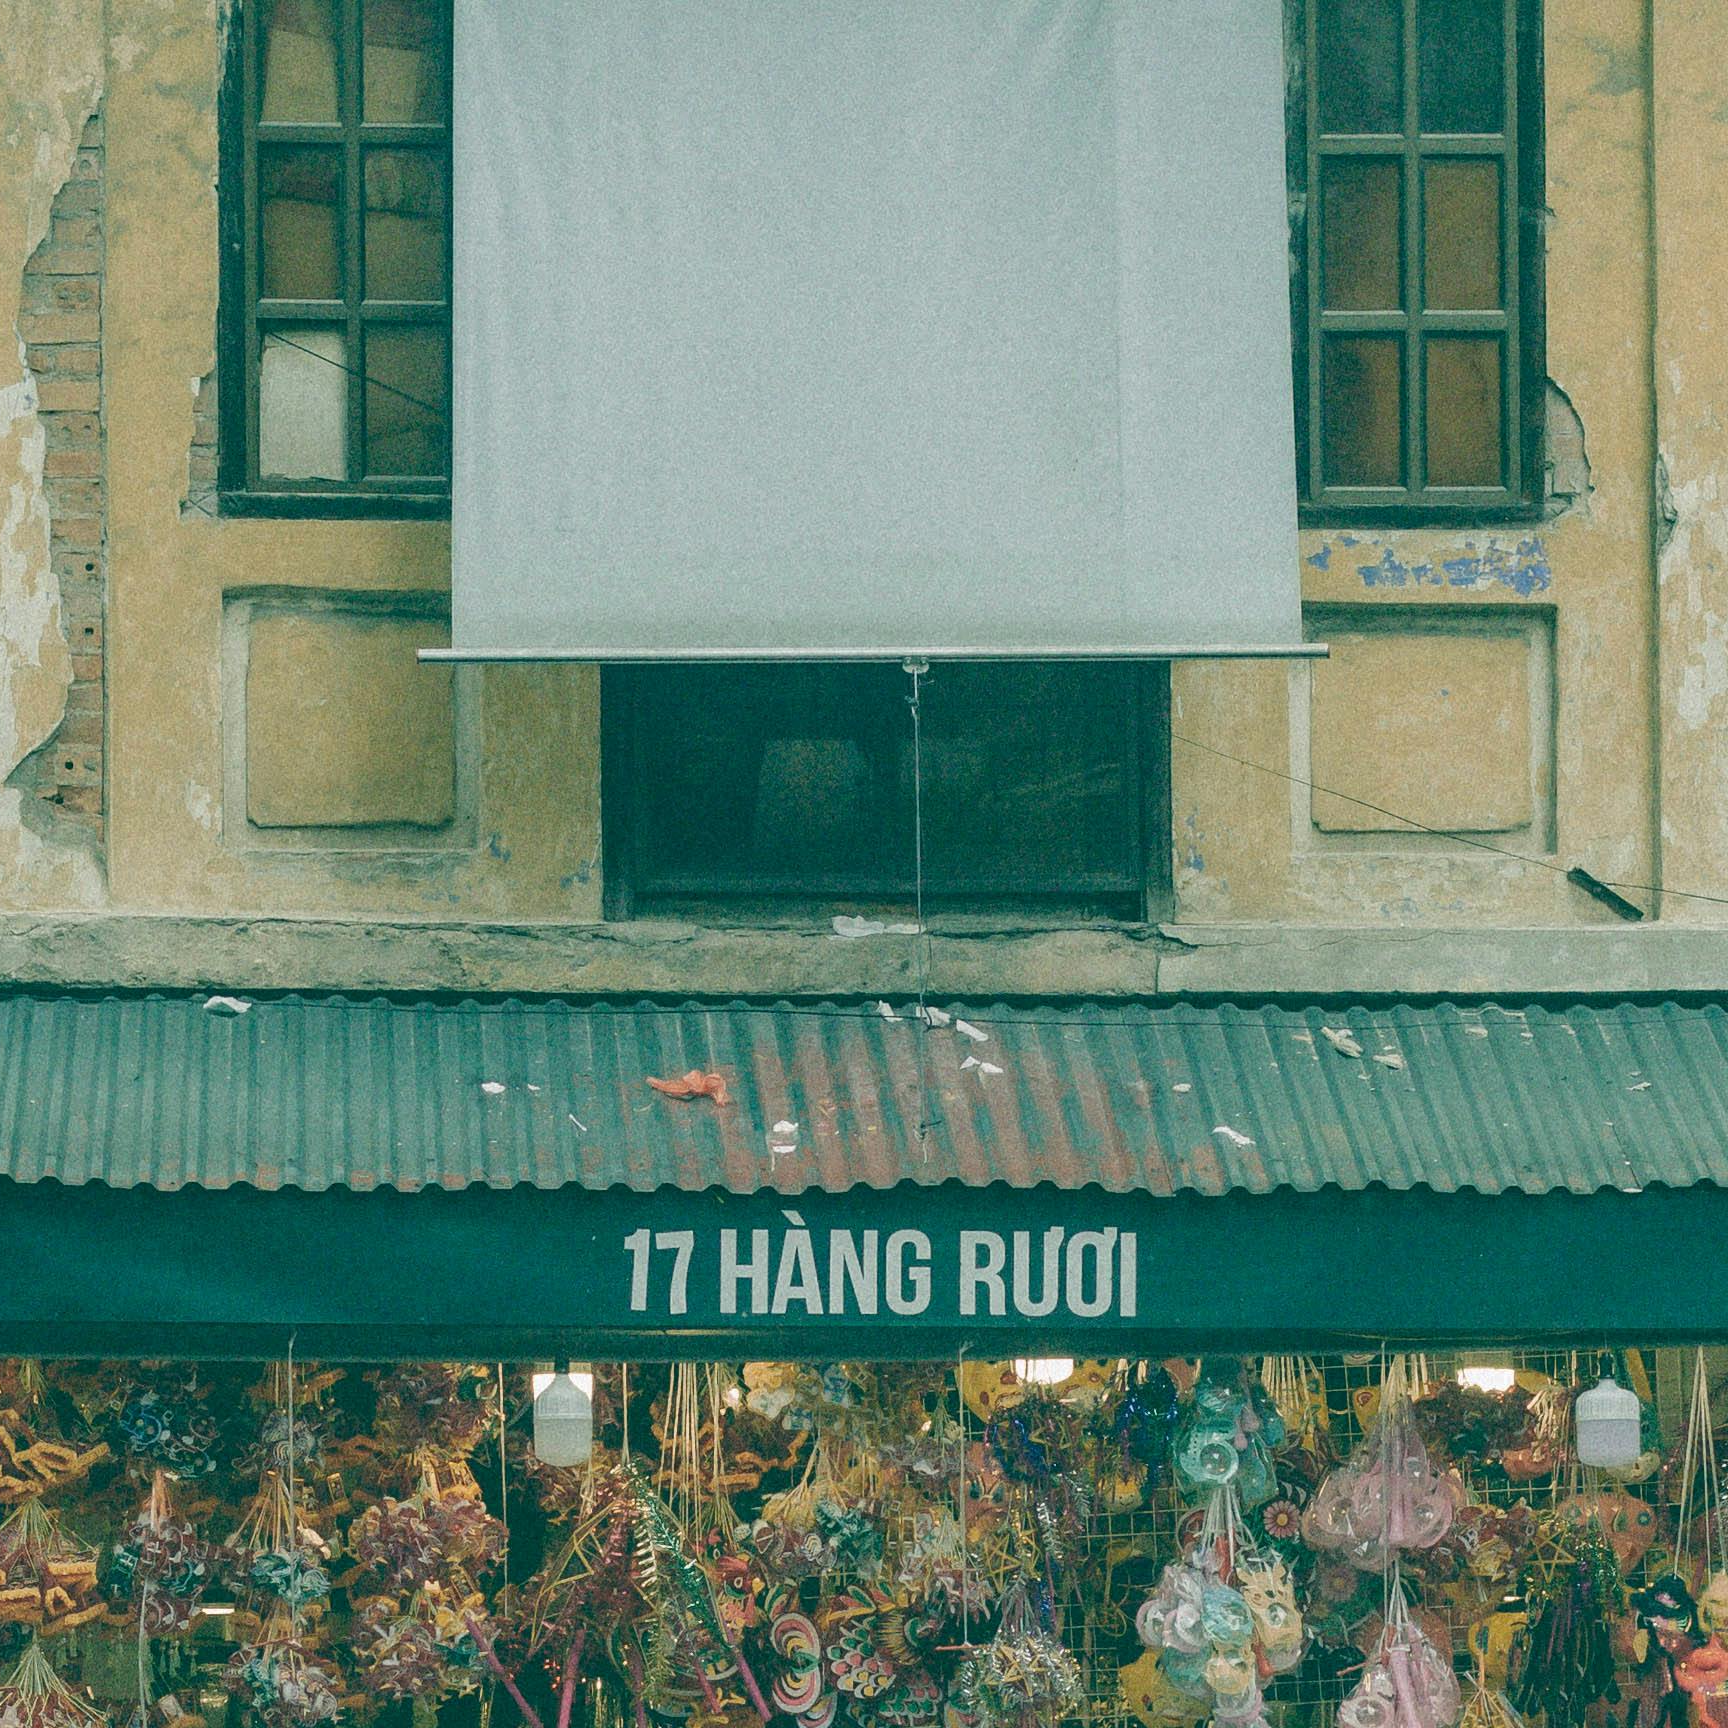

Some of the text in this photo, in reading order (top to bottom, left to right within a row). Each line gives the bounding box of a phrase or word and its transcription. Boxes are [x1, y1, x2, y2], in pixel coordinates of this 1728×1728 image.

[623, 1209, 1138, 1318] 17 HÀNG RƯƠI
